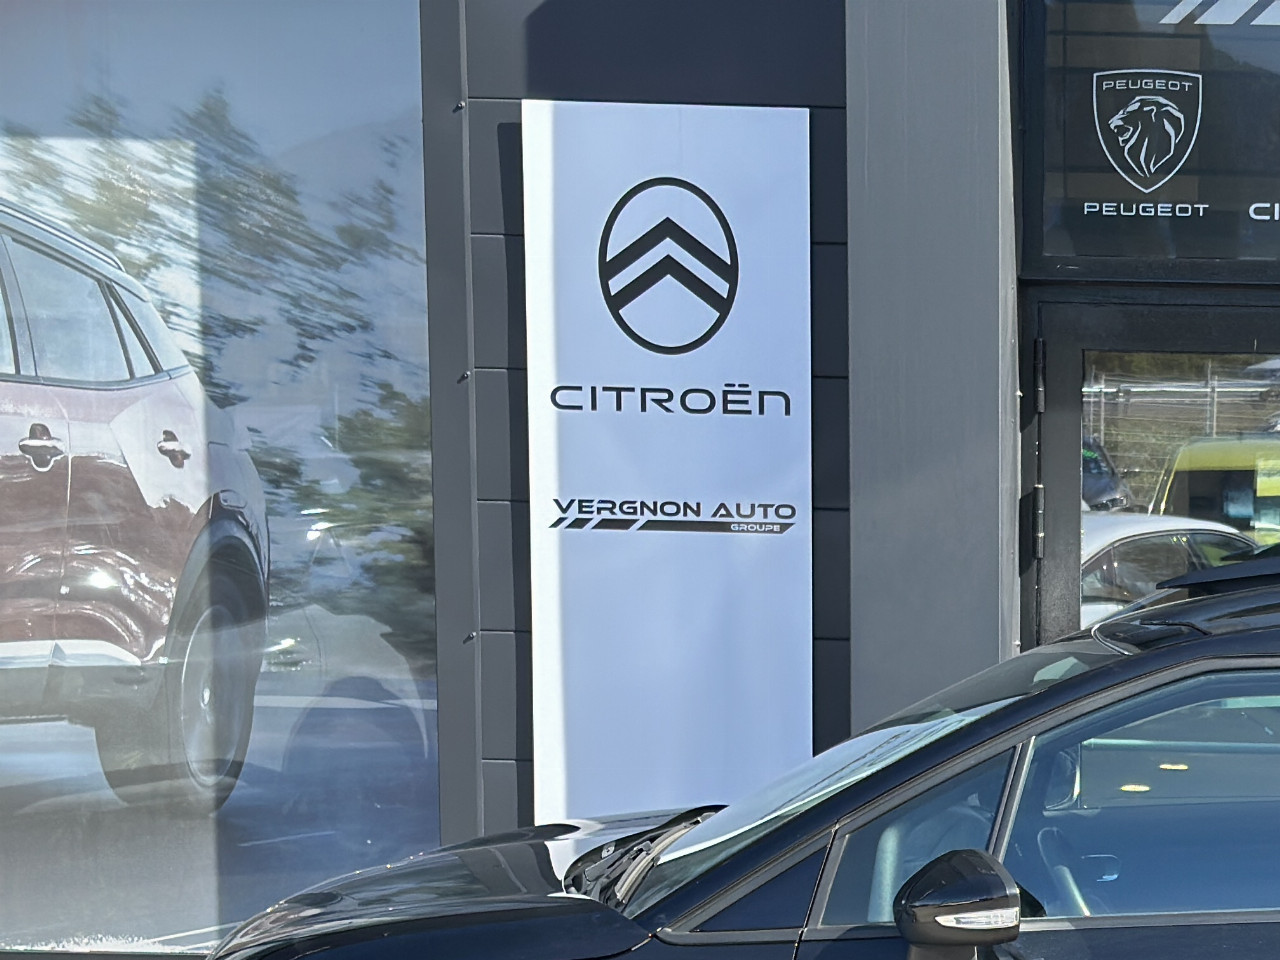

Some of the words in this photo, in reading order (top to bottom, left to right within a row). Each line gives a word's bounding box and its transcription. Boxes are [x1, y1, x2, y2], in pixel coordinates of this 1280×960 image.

[1102, 79, 1193, 91] PEUGEOT
[1083, 202, 1210, 217] PEUGEOT
[549, 382, 791, 417] CITROËN
[552, 498, 702, 517] VERGNON
[711, 502, 797, 520] AUTO
[730, 523, 781, 532] GROUPE
